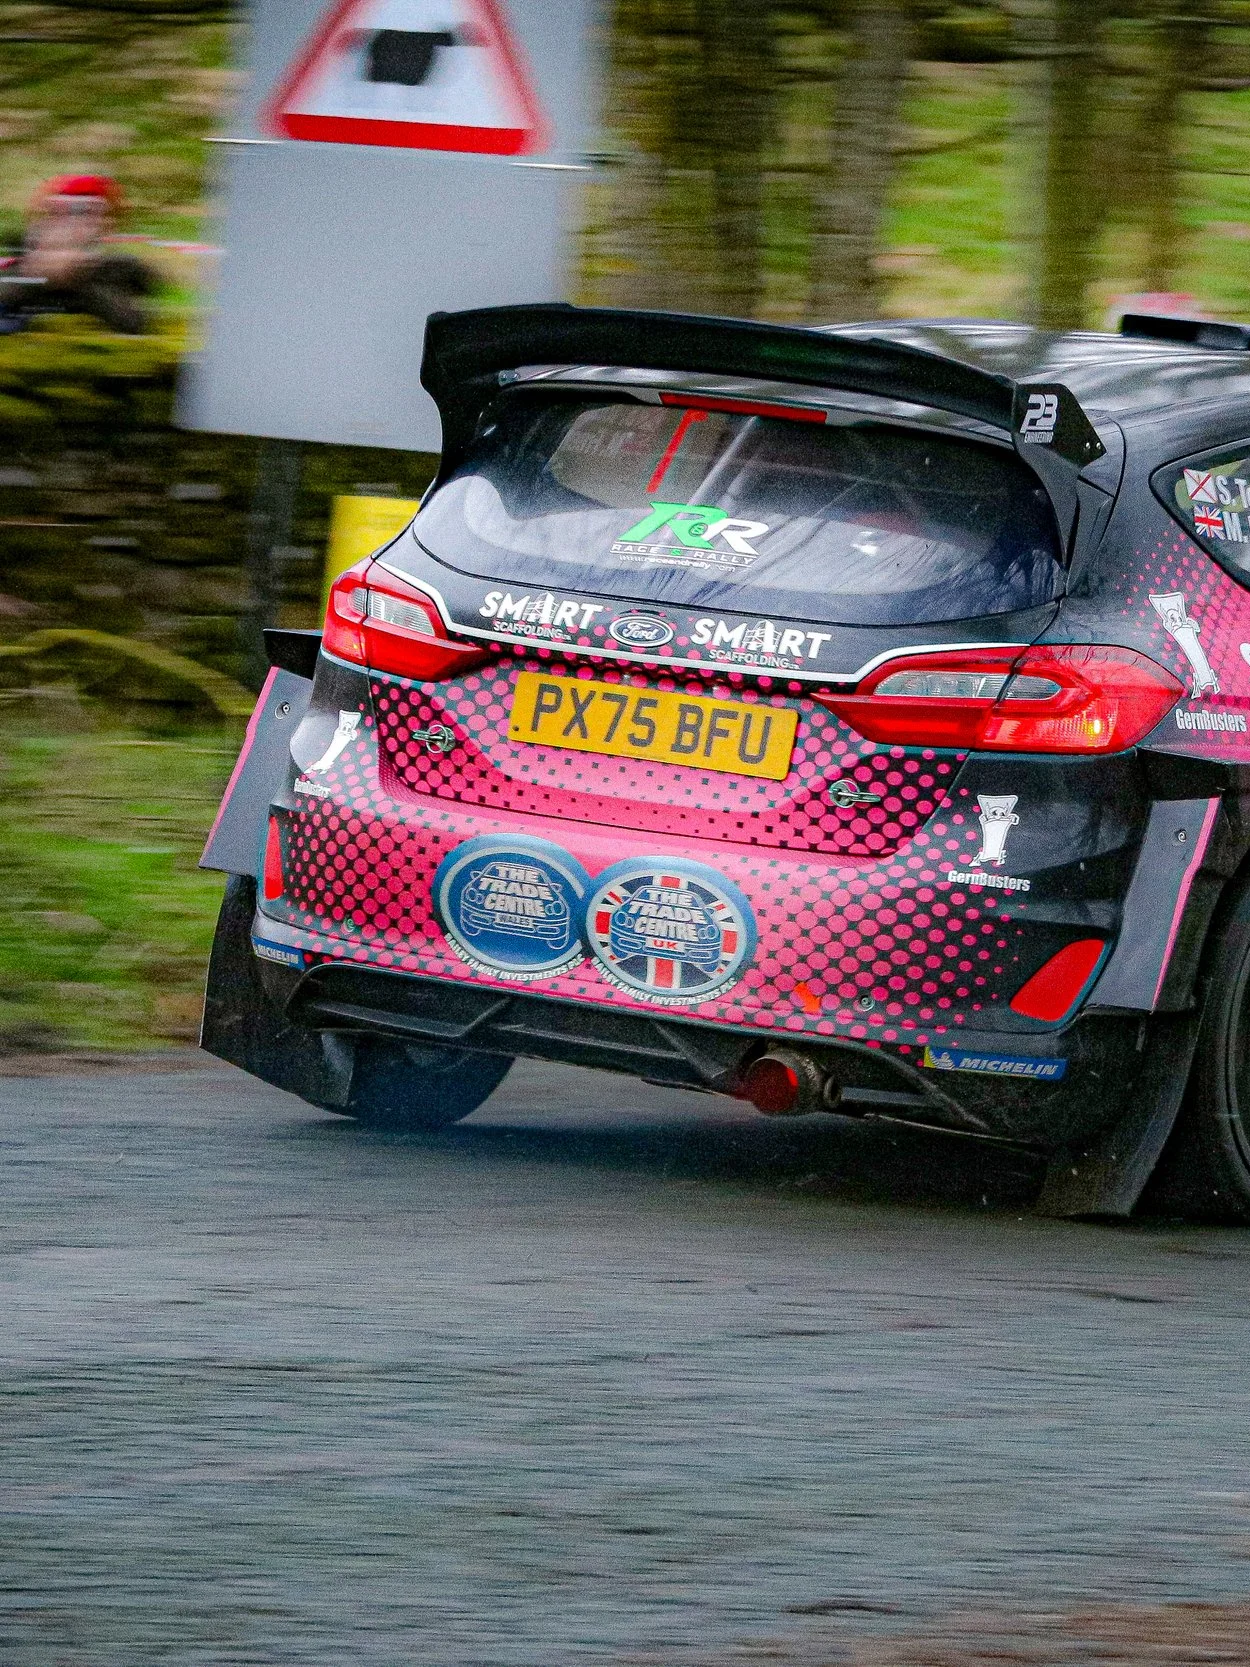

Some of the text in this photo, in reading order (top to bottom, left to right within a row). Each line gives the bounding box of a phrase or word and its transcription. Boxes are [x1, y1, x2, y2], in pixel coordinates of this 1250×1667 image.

[1216, 475, 1236, 505] S.
[1223, 511, 1249, 544] M.
[611, 543, 661, 555] RACE
[692, 551, 754, 566] RALLY
[479, 591, 604, 630] SMART
[493, 620, 565, 641] SCAFFOLDING
[622, 621, 658, 641] Ford
[690, 617, 832, 660] SMART
[708, 648, 790, 669] SCAFFOLDING
[531, 682, 773, 765] PX75 BFU
[496, 865, 540, 883] THE
[478, 877, 555, 901] TRADE
[646, 889, 694, 908] THE
[483, 892, 547, 918] CENTRE
[627, 900, 709, 925] TRADE
[633, 916, 700, 942] CENTRE
[653, 939, 678, 949] UK
[959, 1056, 1059, 1077] MICHELIN
